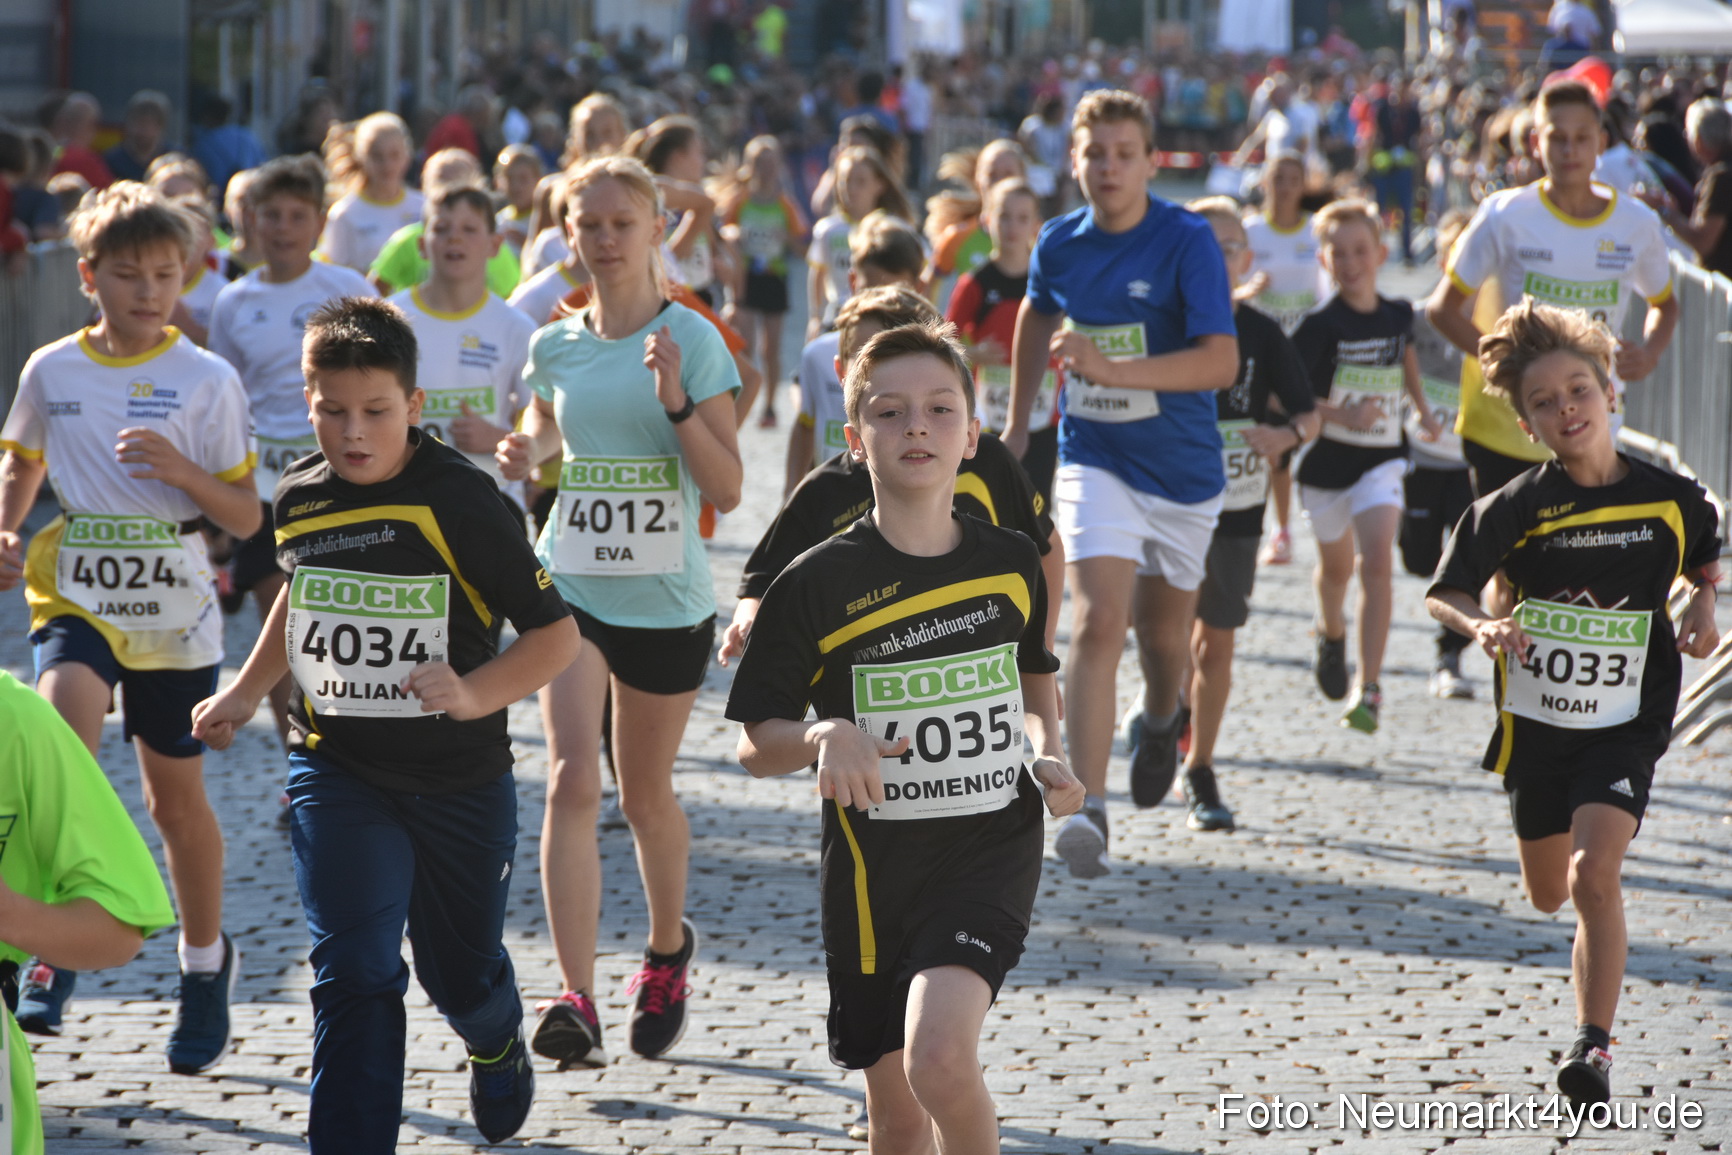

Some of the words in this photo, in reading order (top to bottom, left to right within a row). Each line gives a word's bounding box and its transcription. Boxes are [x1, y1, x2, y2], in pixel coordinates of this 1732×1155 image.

[129, 382, 154, 398] 20
[421, 392, 486, 412] OCK
[570, 464, 666, 487] BOCK
[287, 499, 334, 517] saller
[568, 498, 666, 535] 4012
[70, 521, 171, 541] BOCK
[594, 546, 634, 562] EVA
[72, 554, 176, 590] 4024
[303, 576, 434, 612] BOCK
[845, 581, 902, 616] saller
[93, 602, 161, 616] JAKOB
[433, 629, 442, 639] J
[852, 600, 1001, 664] www.mk-abdichtungen.de
[1522, 605, 1637, 642] BOCK
[301, 620, 430, 668] 4034
[1521, 643, 1628, 687] 4033
[316, 680, 409, 701] JULIAN
[869, 656, 1009, 703] BOCK
[1013, 703, 1018, 713] J
[1541, 693, 1598, 714] NOAH
[882, 703, 1012, 765] 4035
[883, 766, 1015, 802] DOMENICO
[969, 937, 991, 953] JAKO
